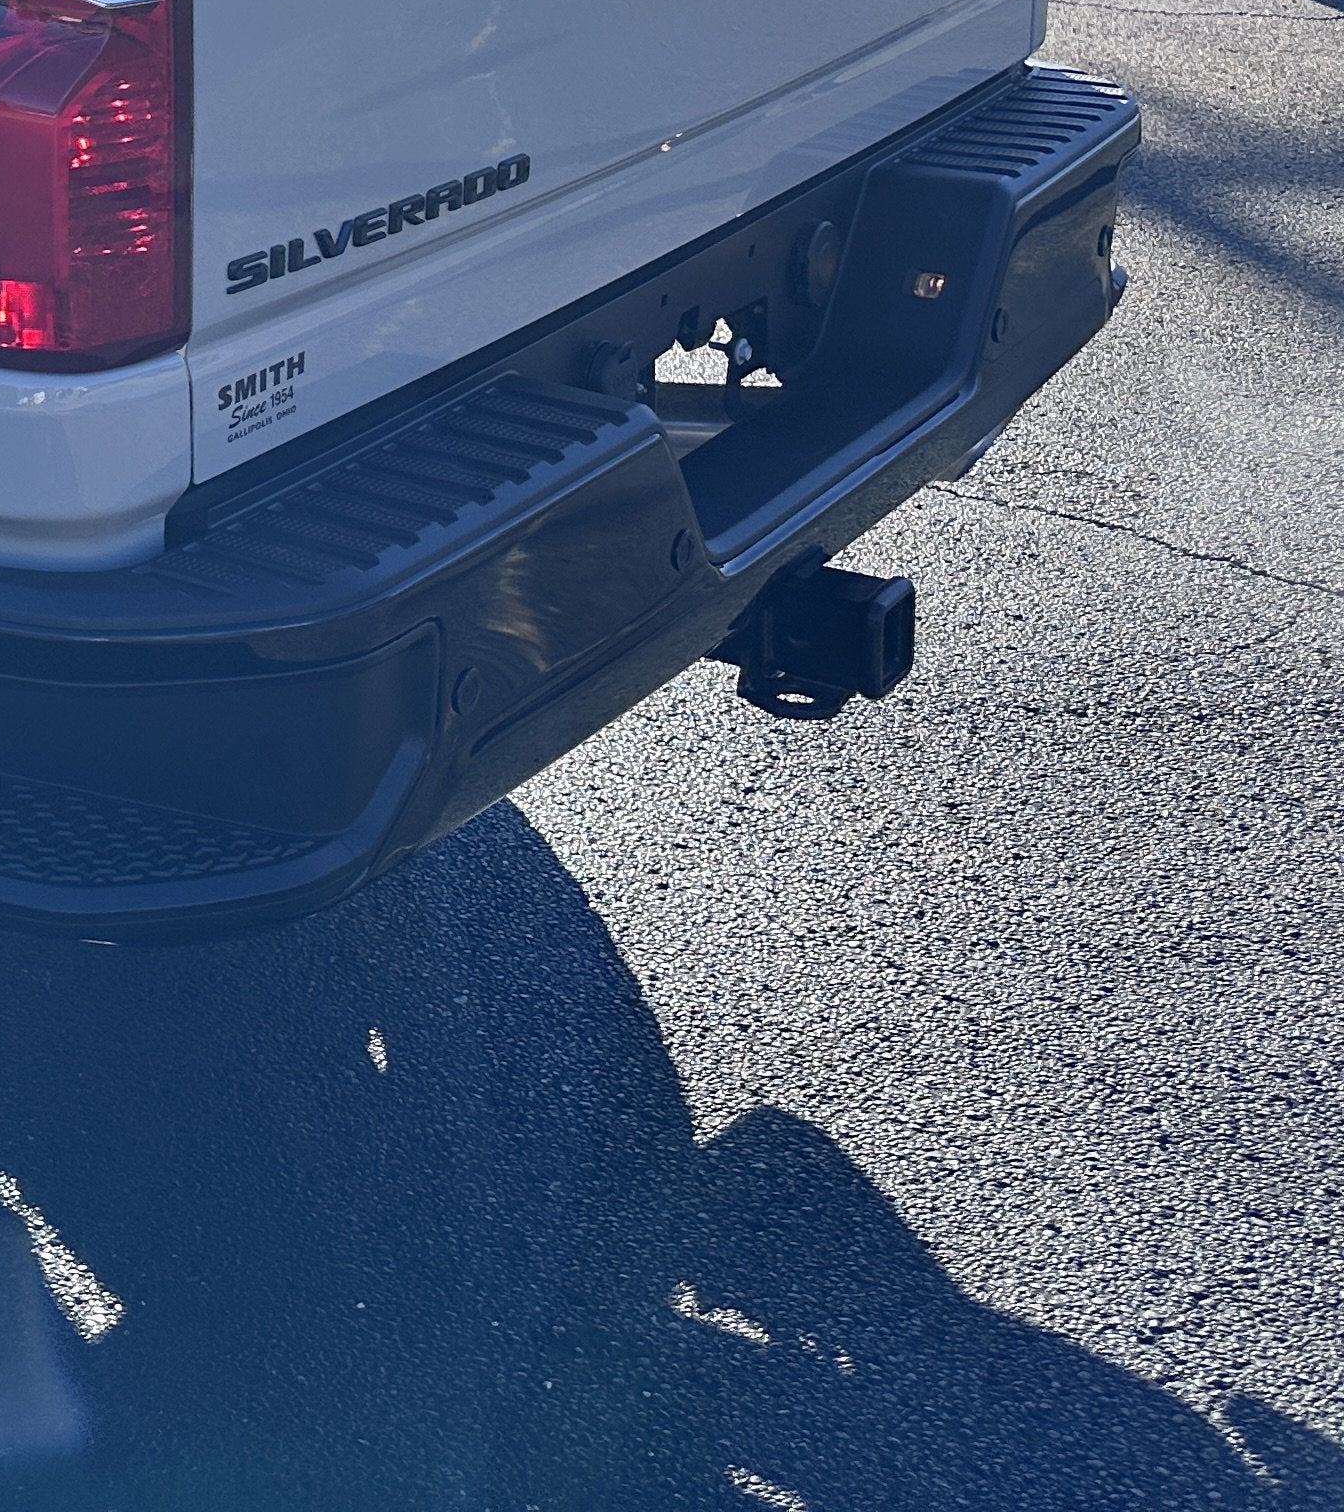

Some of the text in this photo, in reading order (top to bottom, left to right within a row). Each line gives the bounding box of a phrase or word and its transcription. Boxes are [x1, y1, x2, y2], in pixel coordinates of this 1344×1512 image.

[226, 153, 530, 294] SILVERADO
[218, 351, 305, 411] SMITH
[228, 385, 295, 429] Since 1954
[227, 405, 297, 442] GALLIPOLIS OHIO
